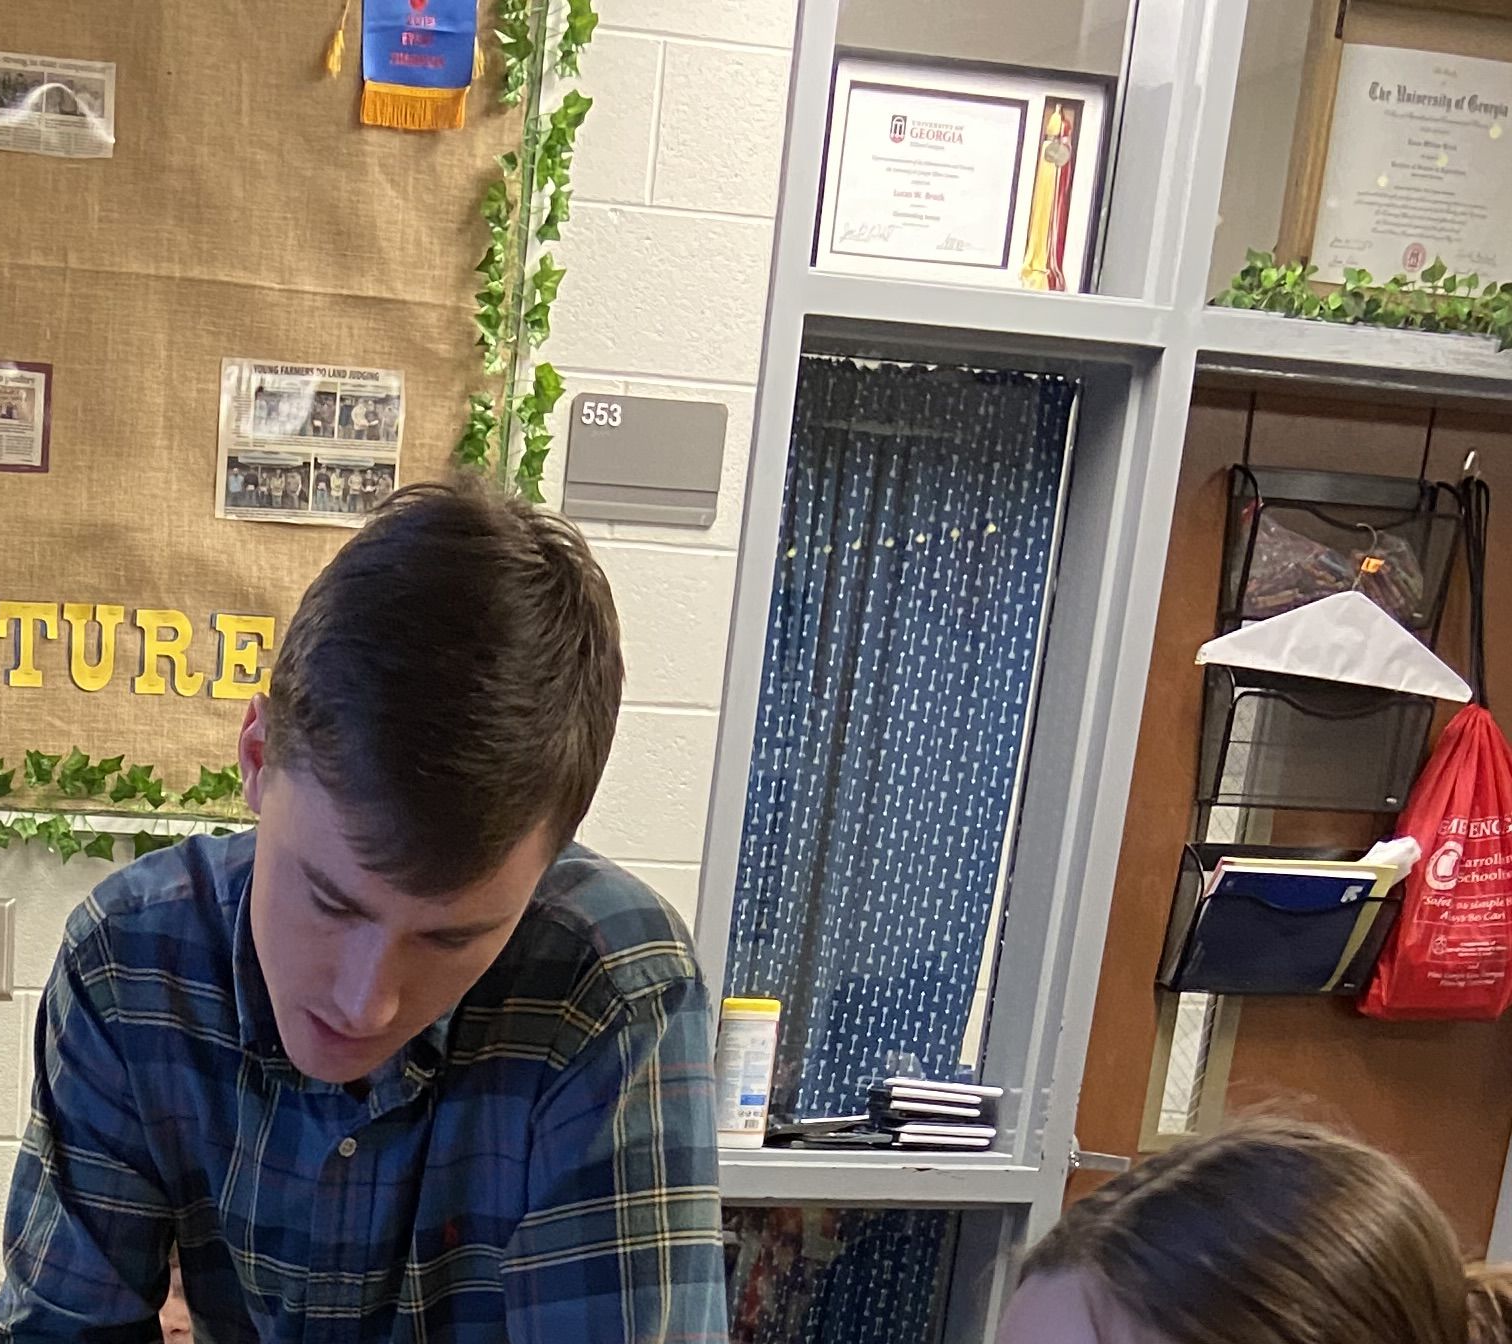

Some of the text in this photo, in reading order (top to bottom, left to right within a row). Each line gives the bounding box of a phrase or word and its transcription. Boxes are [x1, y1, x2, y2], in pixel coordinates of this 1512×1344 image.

[1368, 81, 1391, 102] The
[1396, 83, 1453, 112] University
[1454, 95, 1465, 111] of
[1467, 93, 1509, 119] Georgia
[911, 120, 953, 131] UNIVERSITY
[910, 127, 963, 144] GEORGIA
[253, 364, 279, 374] YOUNG
[280, 365, 314, 377] FARMERS
[328, 368, 346, 379] LAND
[348, 371, 380, 382] JUDGING
[581, 401, 622, 427] 553
